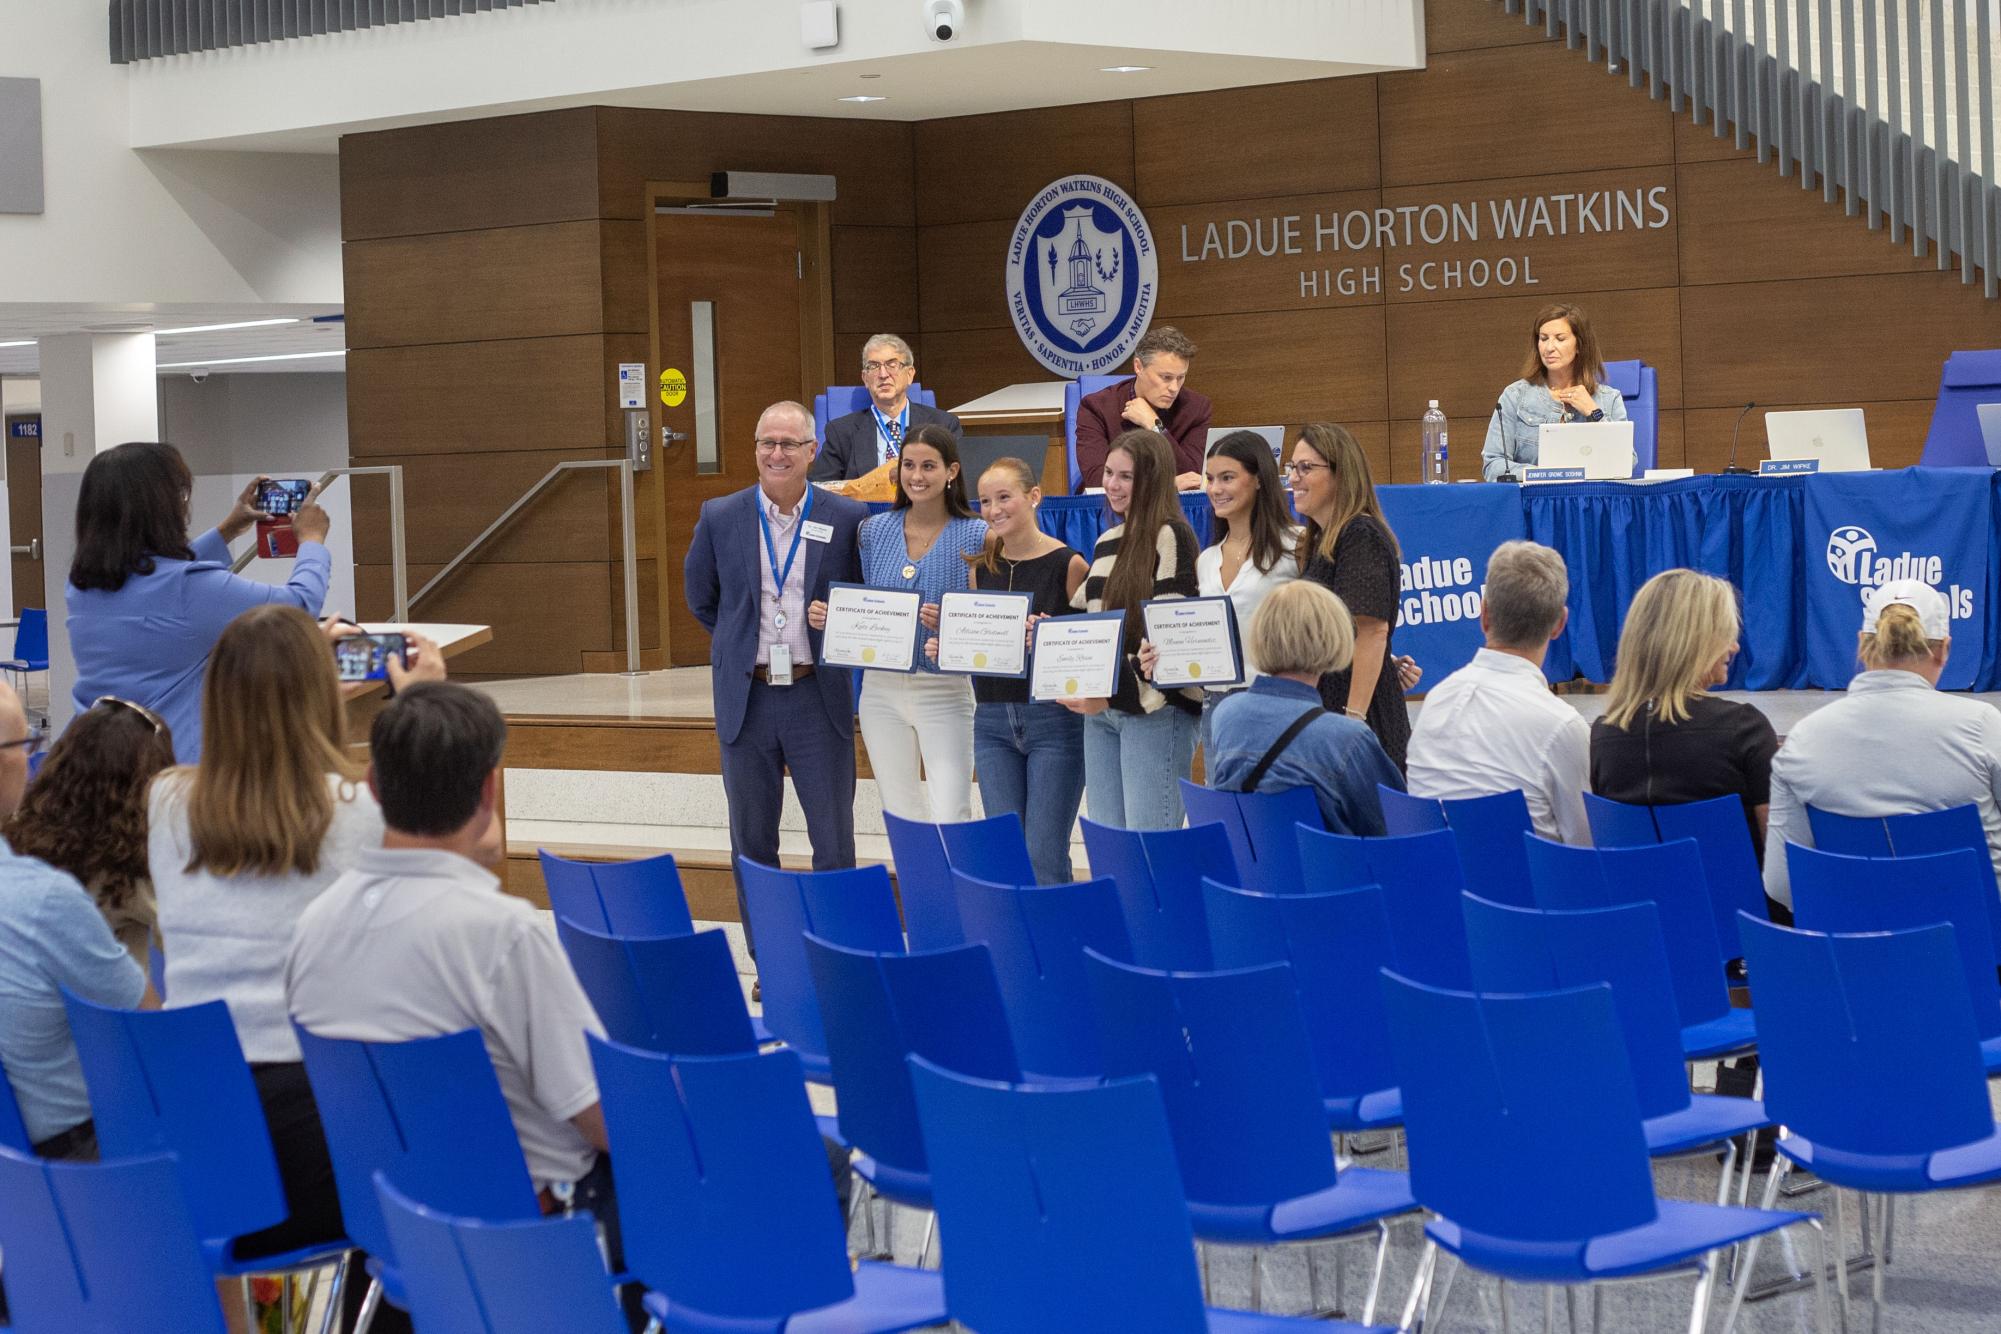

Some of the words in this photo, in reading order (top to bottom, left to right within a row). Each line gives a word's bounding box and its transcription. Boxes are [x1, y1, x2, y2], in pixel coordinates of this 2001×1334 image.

[1011, 225, 1029, 266] LADUE
[1025, 186, 1060, 223] HORTON
[1059, 180, 1103, 195] WATKINS
[1102, 186, 1126, 212] HIGH
[1125, 206, 1151, 257] SCHOOL
[1181, 215, 1302, 262] LADUE
[1315, 201, 1478, 253] HORTON
[1489, 186, 1670, 239] WATKINS
[1300, 265, 1381, 298] HIGH
[1399, 256, 1539, 292] SCHOOL
[1070, 299, 1094, 309] LHWHS
[1013, 291, 1035, 341] VERITAS
[1037, 343, 1085, 373] SAPIENTIA
[1091, 342, 1126, 372] HONOR
[1128, 283, 1151, 341] AMICITIA
[18, 423, 38, 436] 1182
[1400, 556, 1472, 592] adue
[1860, 551, 1942, 586] Ladue
[836, 606, 866, 614] CERTIFICATE
[1154, 622, 1181, 630] CERTIFICATE
